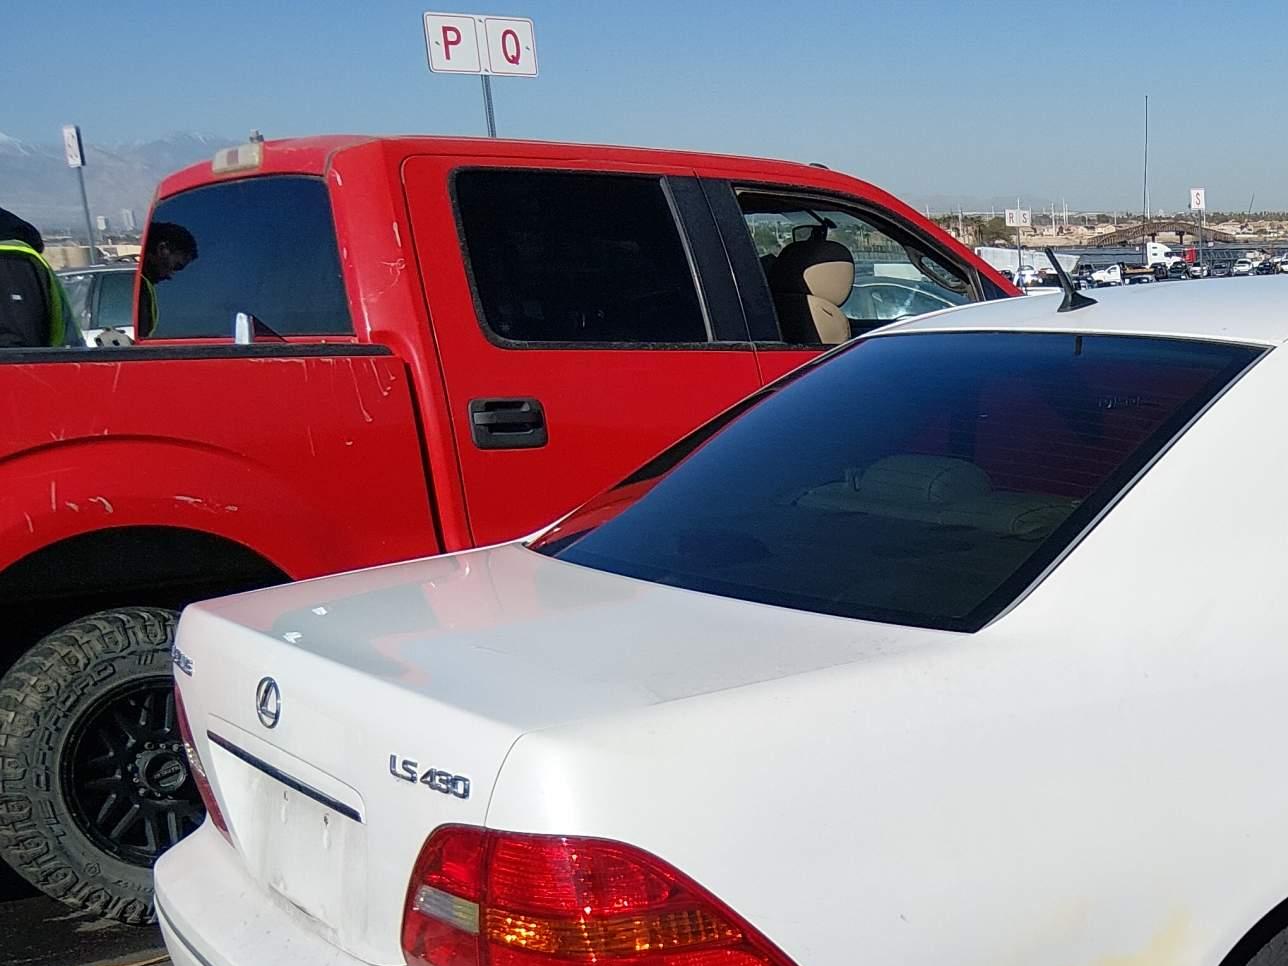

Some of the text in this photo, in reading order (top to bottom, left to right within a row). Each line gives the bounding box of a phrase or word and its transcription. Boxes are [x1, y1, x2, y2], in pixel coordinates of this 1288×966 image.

[442, 26, 521, 65] P Q
[1195, 191, 1201, 206] S
[1008, 212, 1028, 224] R S
[389, 754, 470, 800] LS 430
